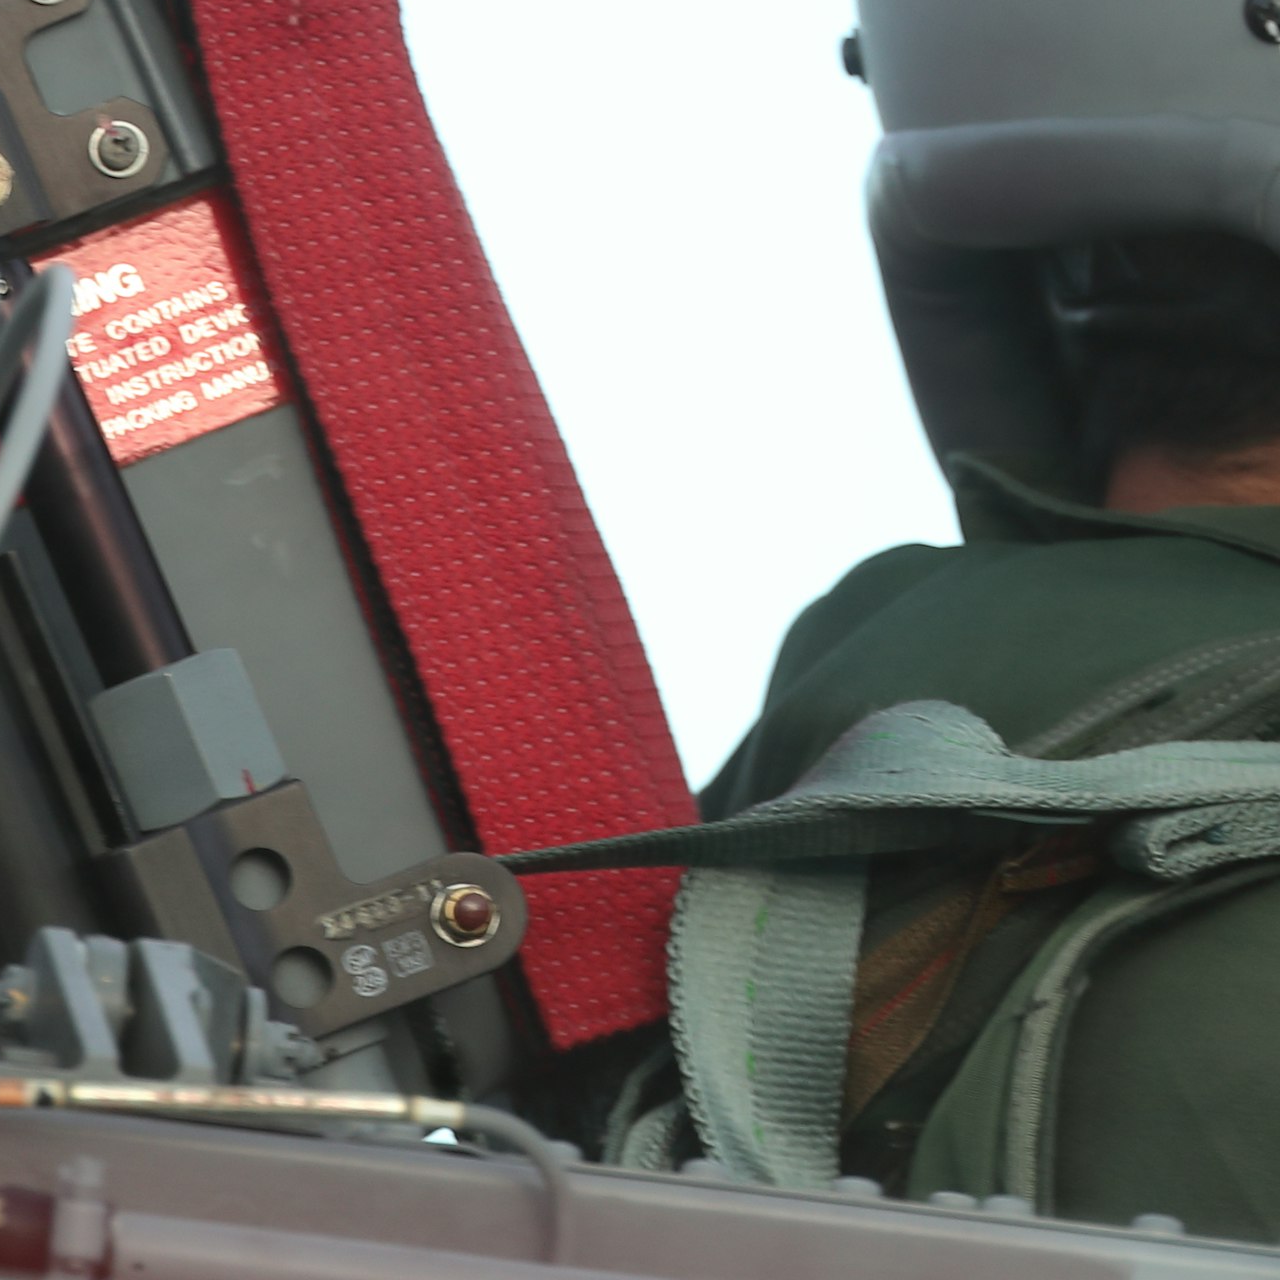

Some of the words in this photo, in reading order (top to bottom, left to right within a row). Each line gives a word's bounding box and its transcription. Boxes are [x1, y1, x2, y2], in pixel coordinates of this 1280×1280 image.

[72, 264, 146, 316] ING
[105, 281, 229, 339] CONTAINS
[101, 390, 197, 440] PACKING
